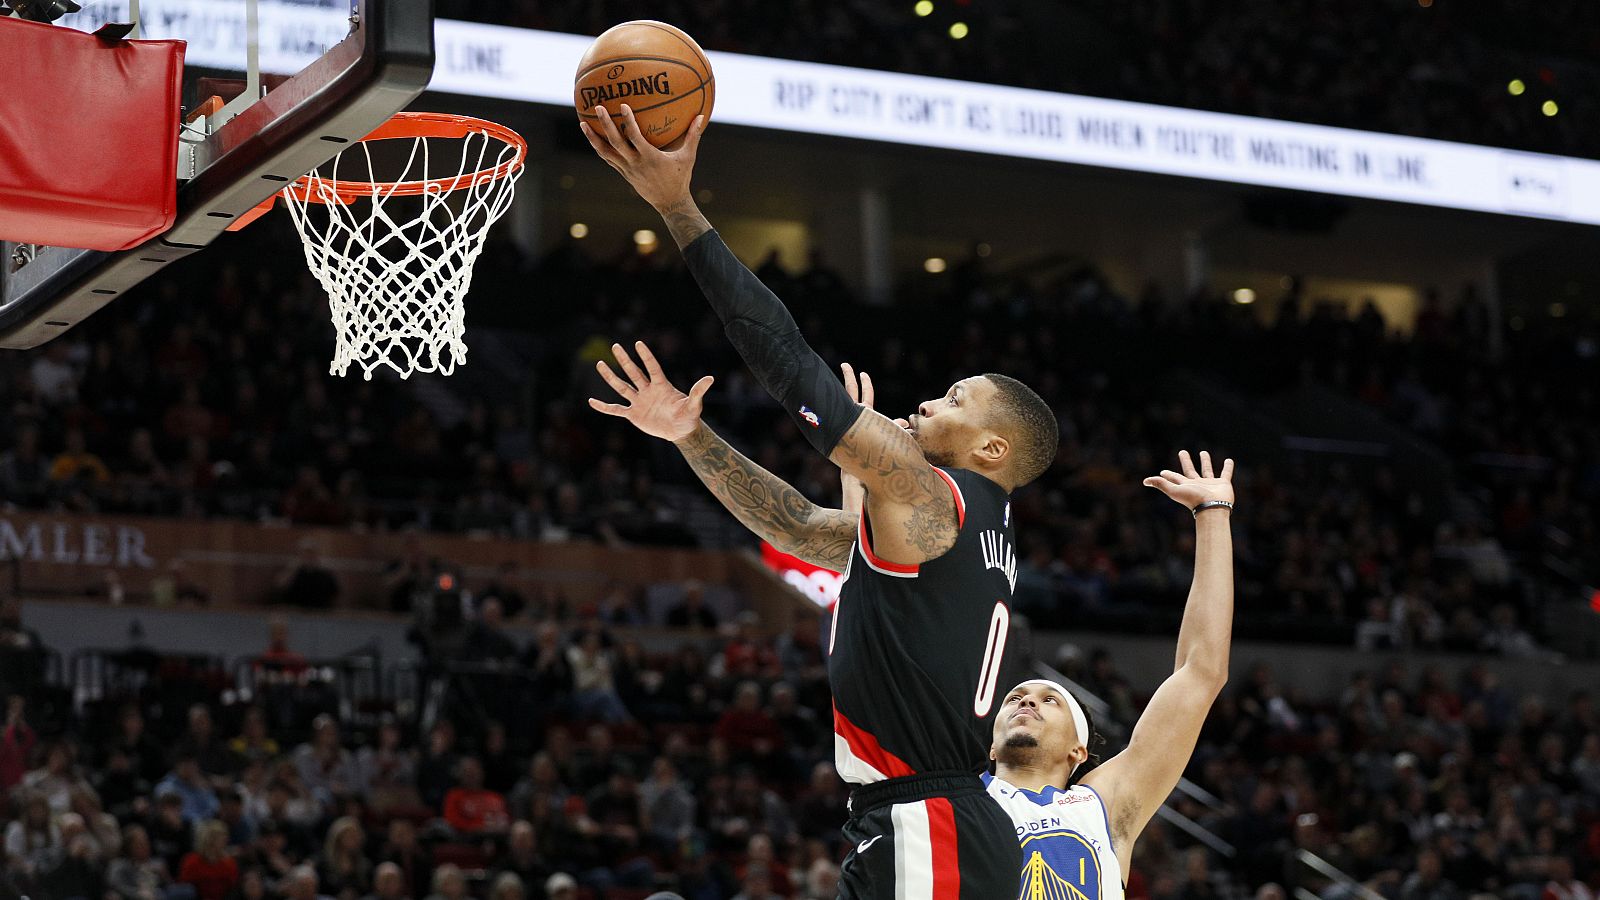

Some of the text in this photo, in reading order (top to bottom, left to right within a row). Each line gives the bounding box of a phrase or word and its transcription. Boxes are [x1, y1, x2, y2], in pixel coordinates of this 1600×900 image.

[580, 71, 671, 111] SPALDING
[773, 79, 814, 111] RIP
[829, 86, 882, 119] CITY
[895, 93, 955, 128] ISN'T
[965, 103, 992, 133] AS
[1002, 106, 1063, 141] LOUD
[1078, 115, 1146, 150] WHEN
[1155, 125, 1236, 162] YOU'RE
[1248, 136, 1340, 173] WAITING
[1353, 150, 1370, 177] IN
[974, 600, 1010, 718] 0
[1016, 817, 1061, 836] OLDEN
